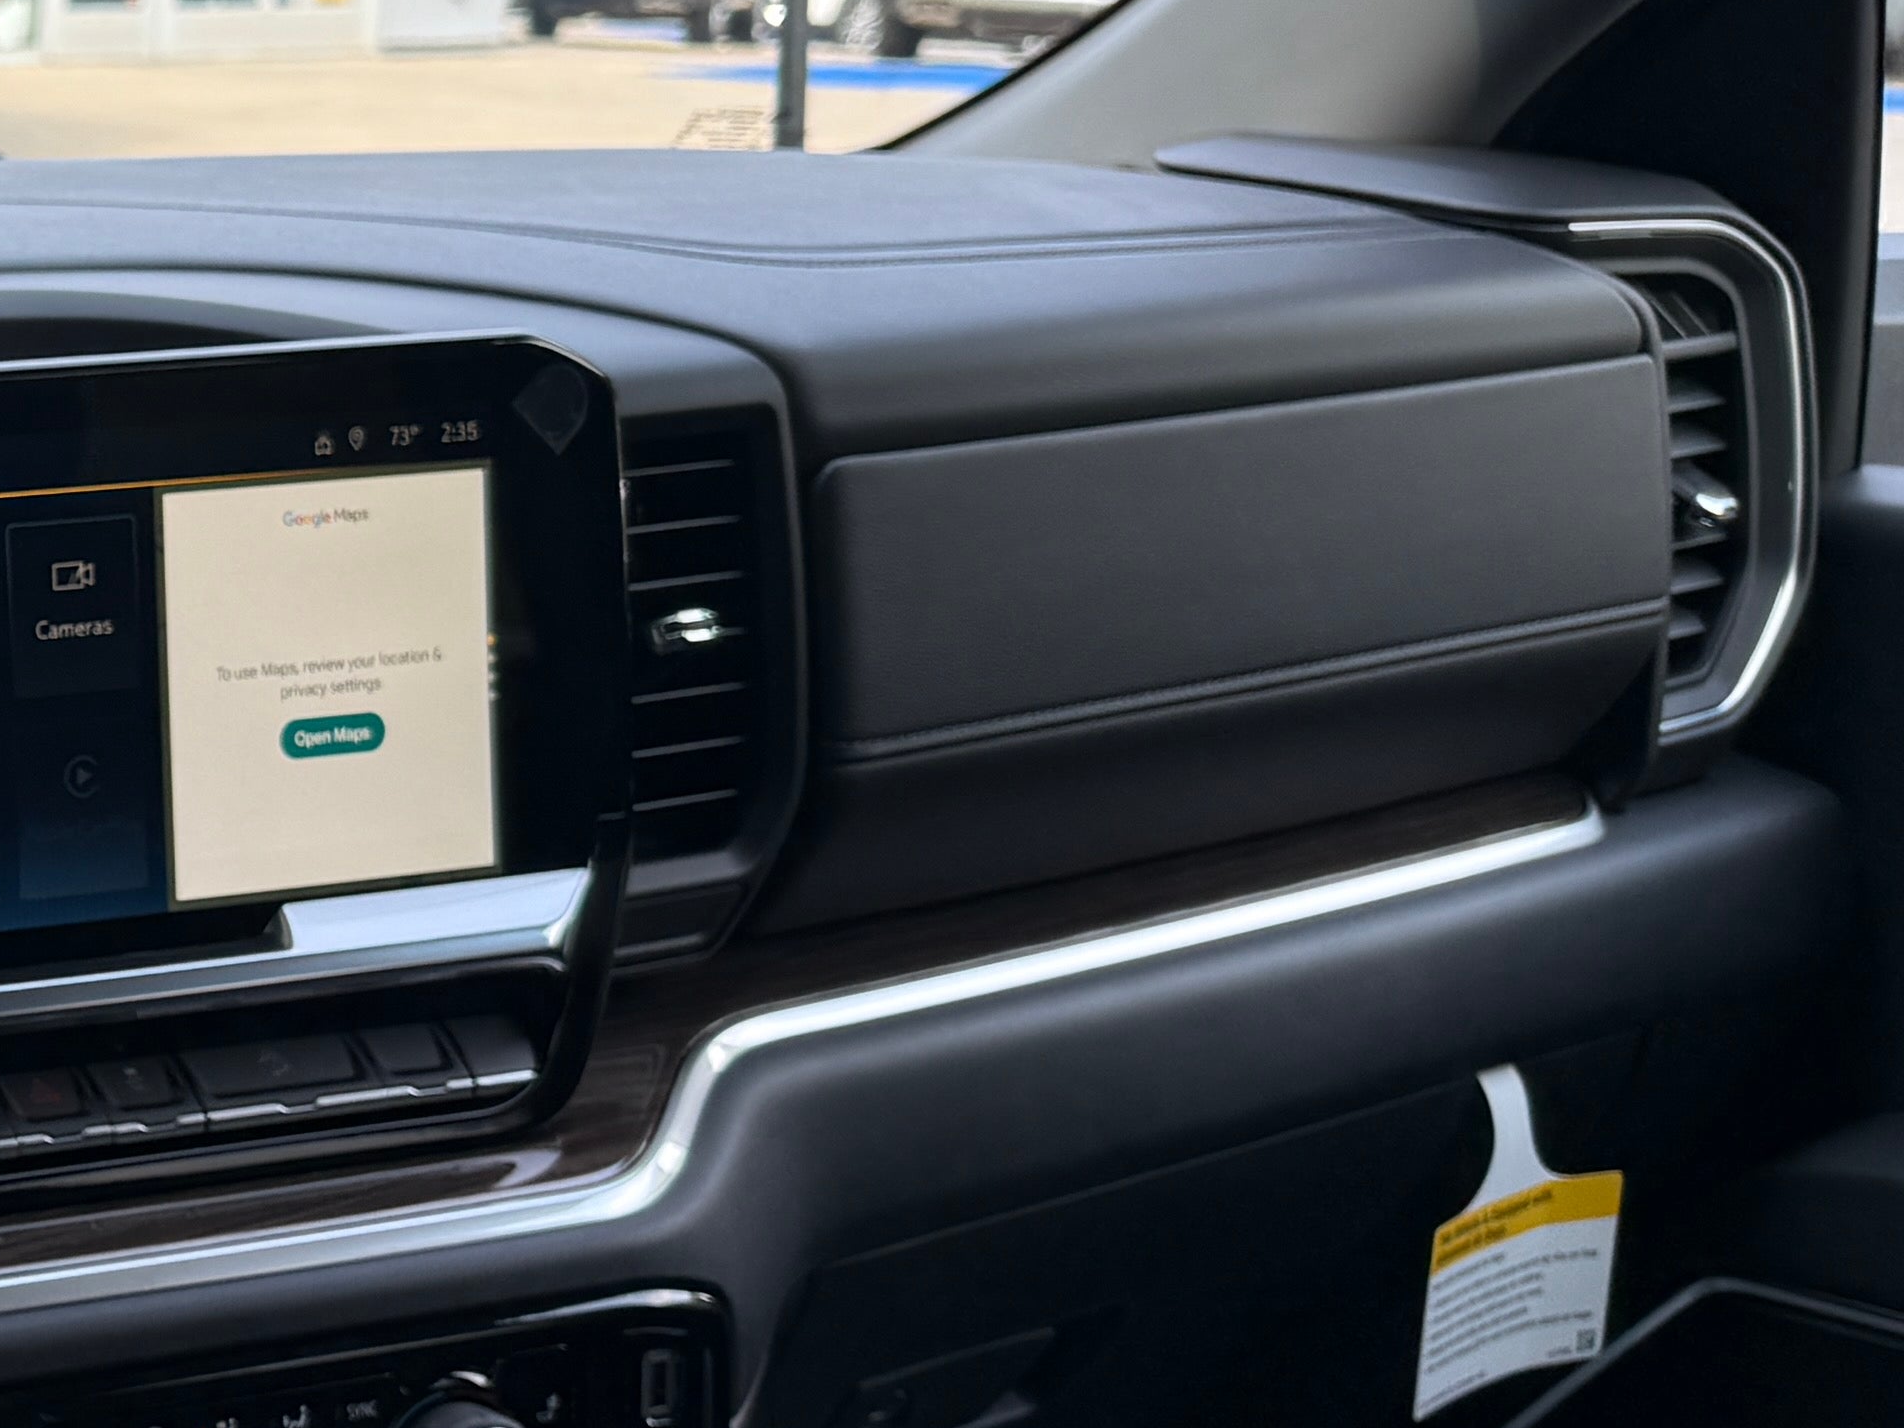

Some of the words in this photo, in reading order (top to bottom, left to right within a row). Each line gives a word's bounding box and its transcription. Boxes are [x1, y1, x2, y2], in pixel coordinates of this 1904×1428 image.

[282, 510, 332, 528] Google
[333, 507, 369, 525] Maps
[35, 617, 115, 642] Cameras
[216, 666, 232, 682] To
[233, 666, 258, 680] use
[302, 658, 345, 674] review
[347, 654, 376, 673] your
[378, 647, 430, 667] location
[280, 681, 327, 702] privacy
[331, 677, 382, 695] settings
[293, 728, 332, 748] Open
[333, 726, 372, 745] Maps
